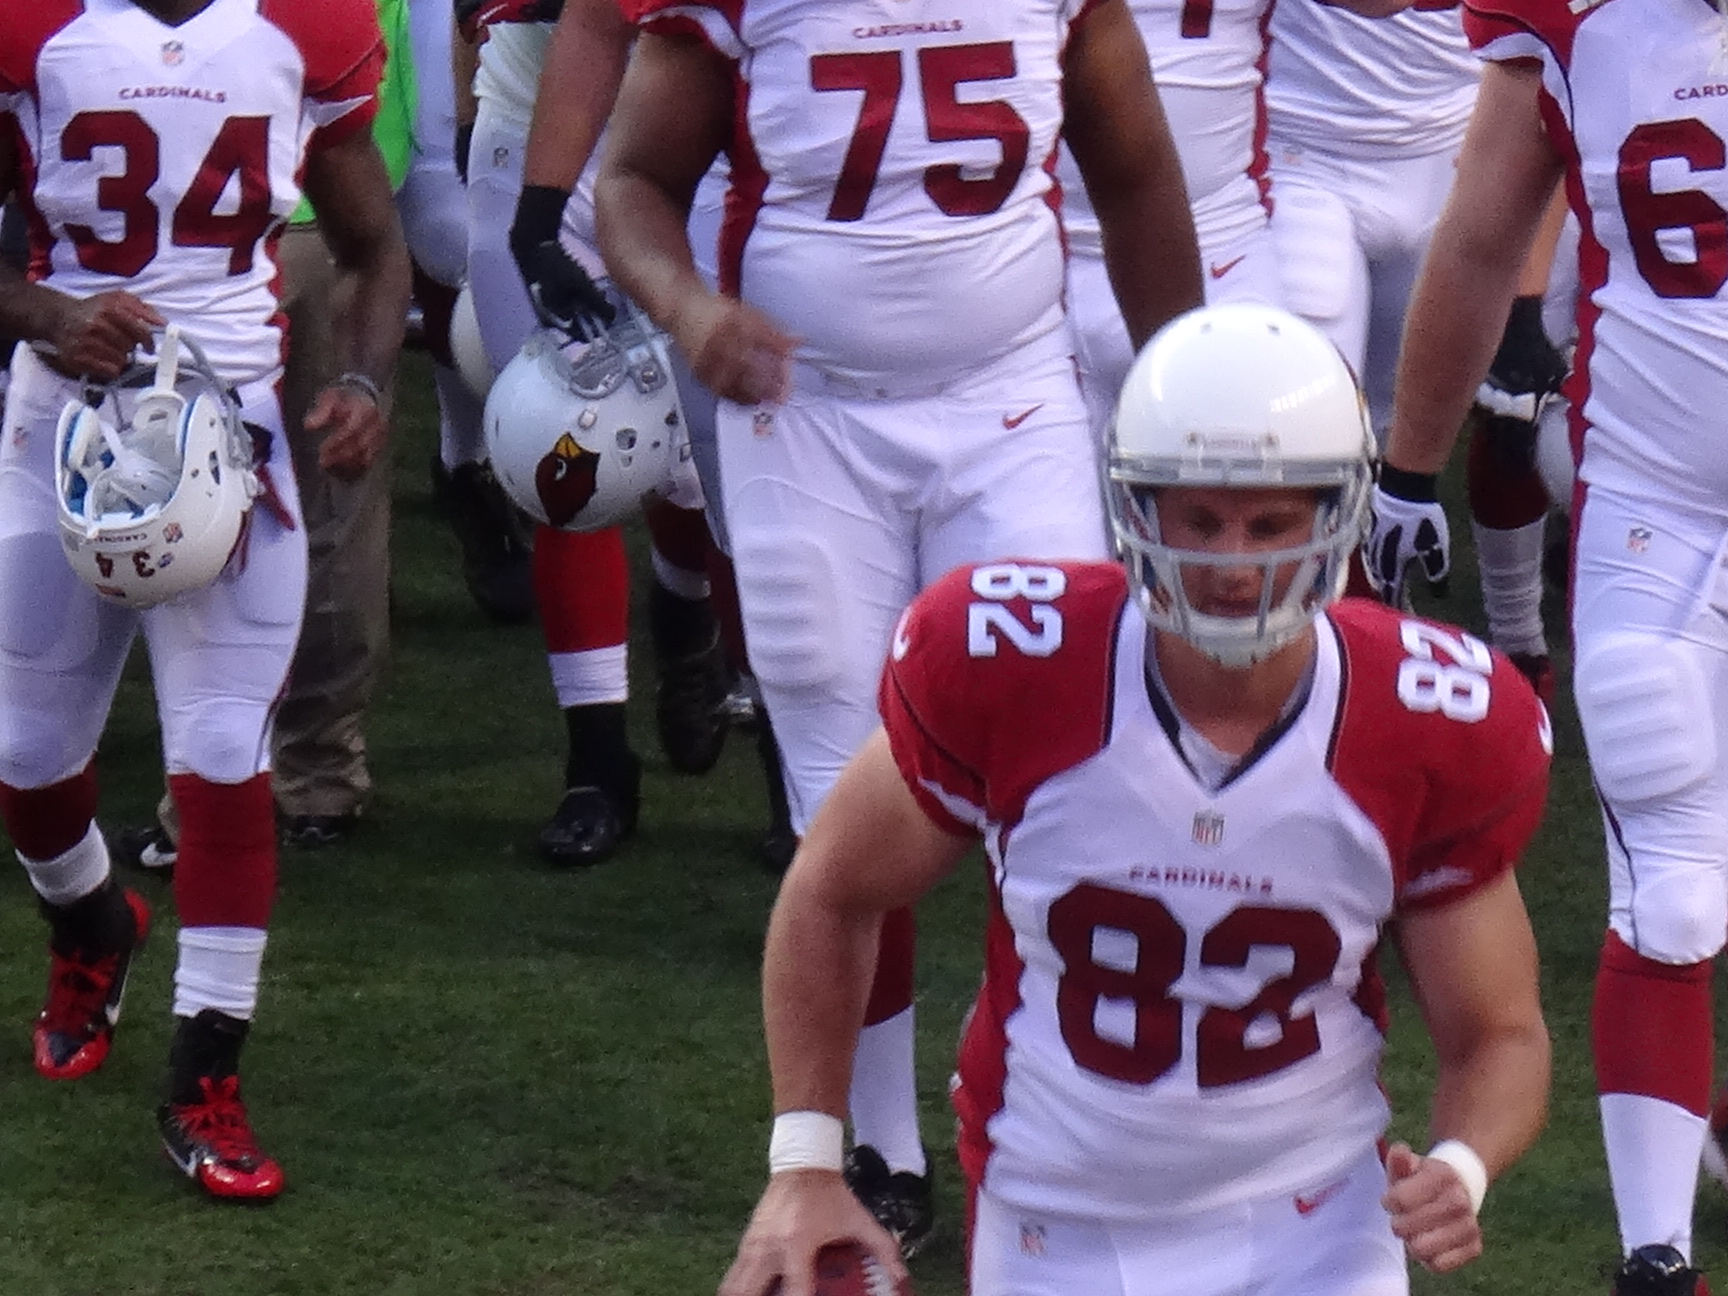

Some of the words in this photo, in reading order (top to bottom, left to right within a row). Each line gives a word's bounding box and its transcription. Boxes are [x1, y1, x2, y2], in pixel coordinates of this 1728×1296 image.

[851, 19, 963, 40] CARDINALS
[118, 87, 227, 104] CARDINALS
[809, 40, 1030, 222] 75
[60, 110, 273, 278] 34
[967, 562, 1066, 658] 82
[1396, 619, 1495, 724] 82
[1047, 878, 1342, 1090] 82
